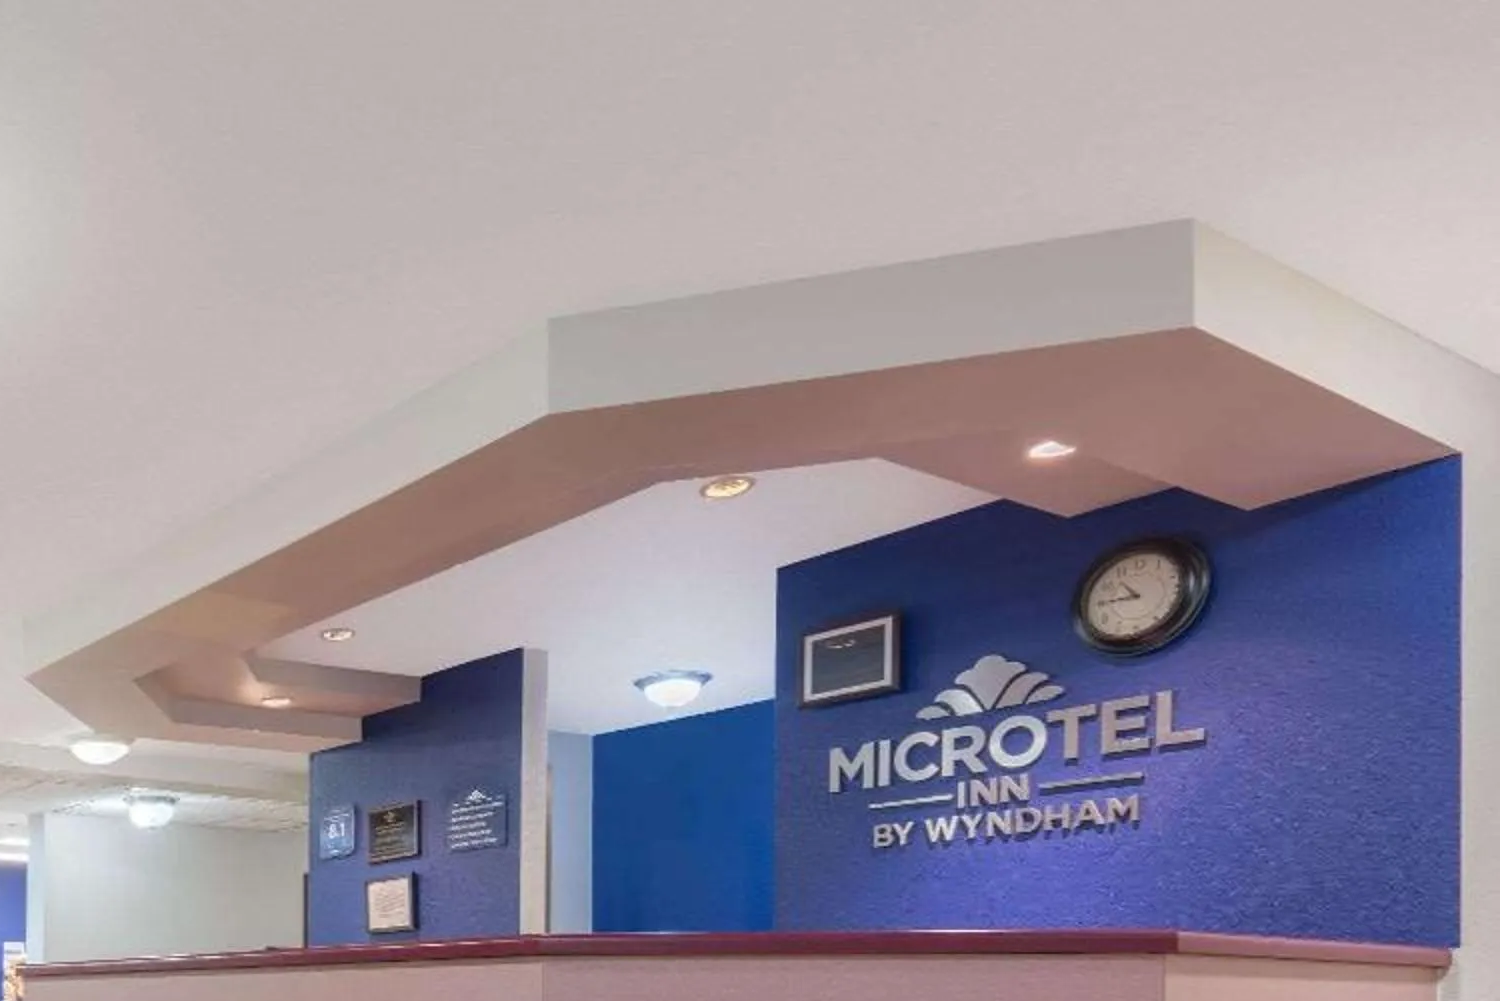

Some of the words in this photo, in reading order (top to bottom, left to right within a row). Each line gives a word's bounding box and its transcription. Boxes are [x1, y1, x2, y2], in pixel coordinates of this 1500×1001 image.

[829, 690, 1205, 793] MICROTEL
[957, 773, 1030, 809] INN
[873, 821, 914, 849] BY
[924, 793, 1140, 843] WYNDHAM
